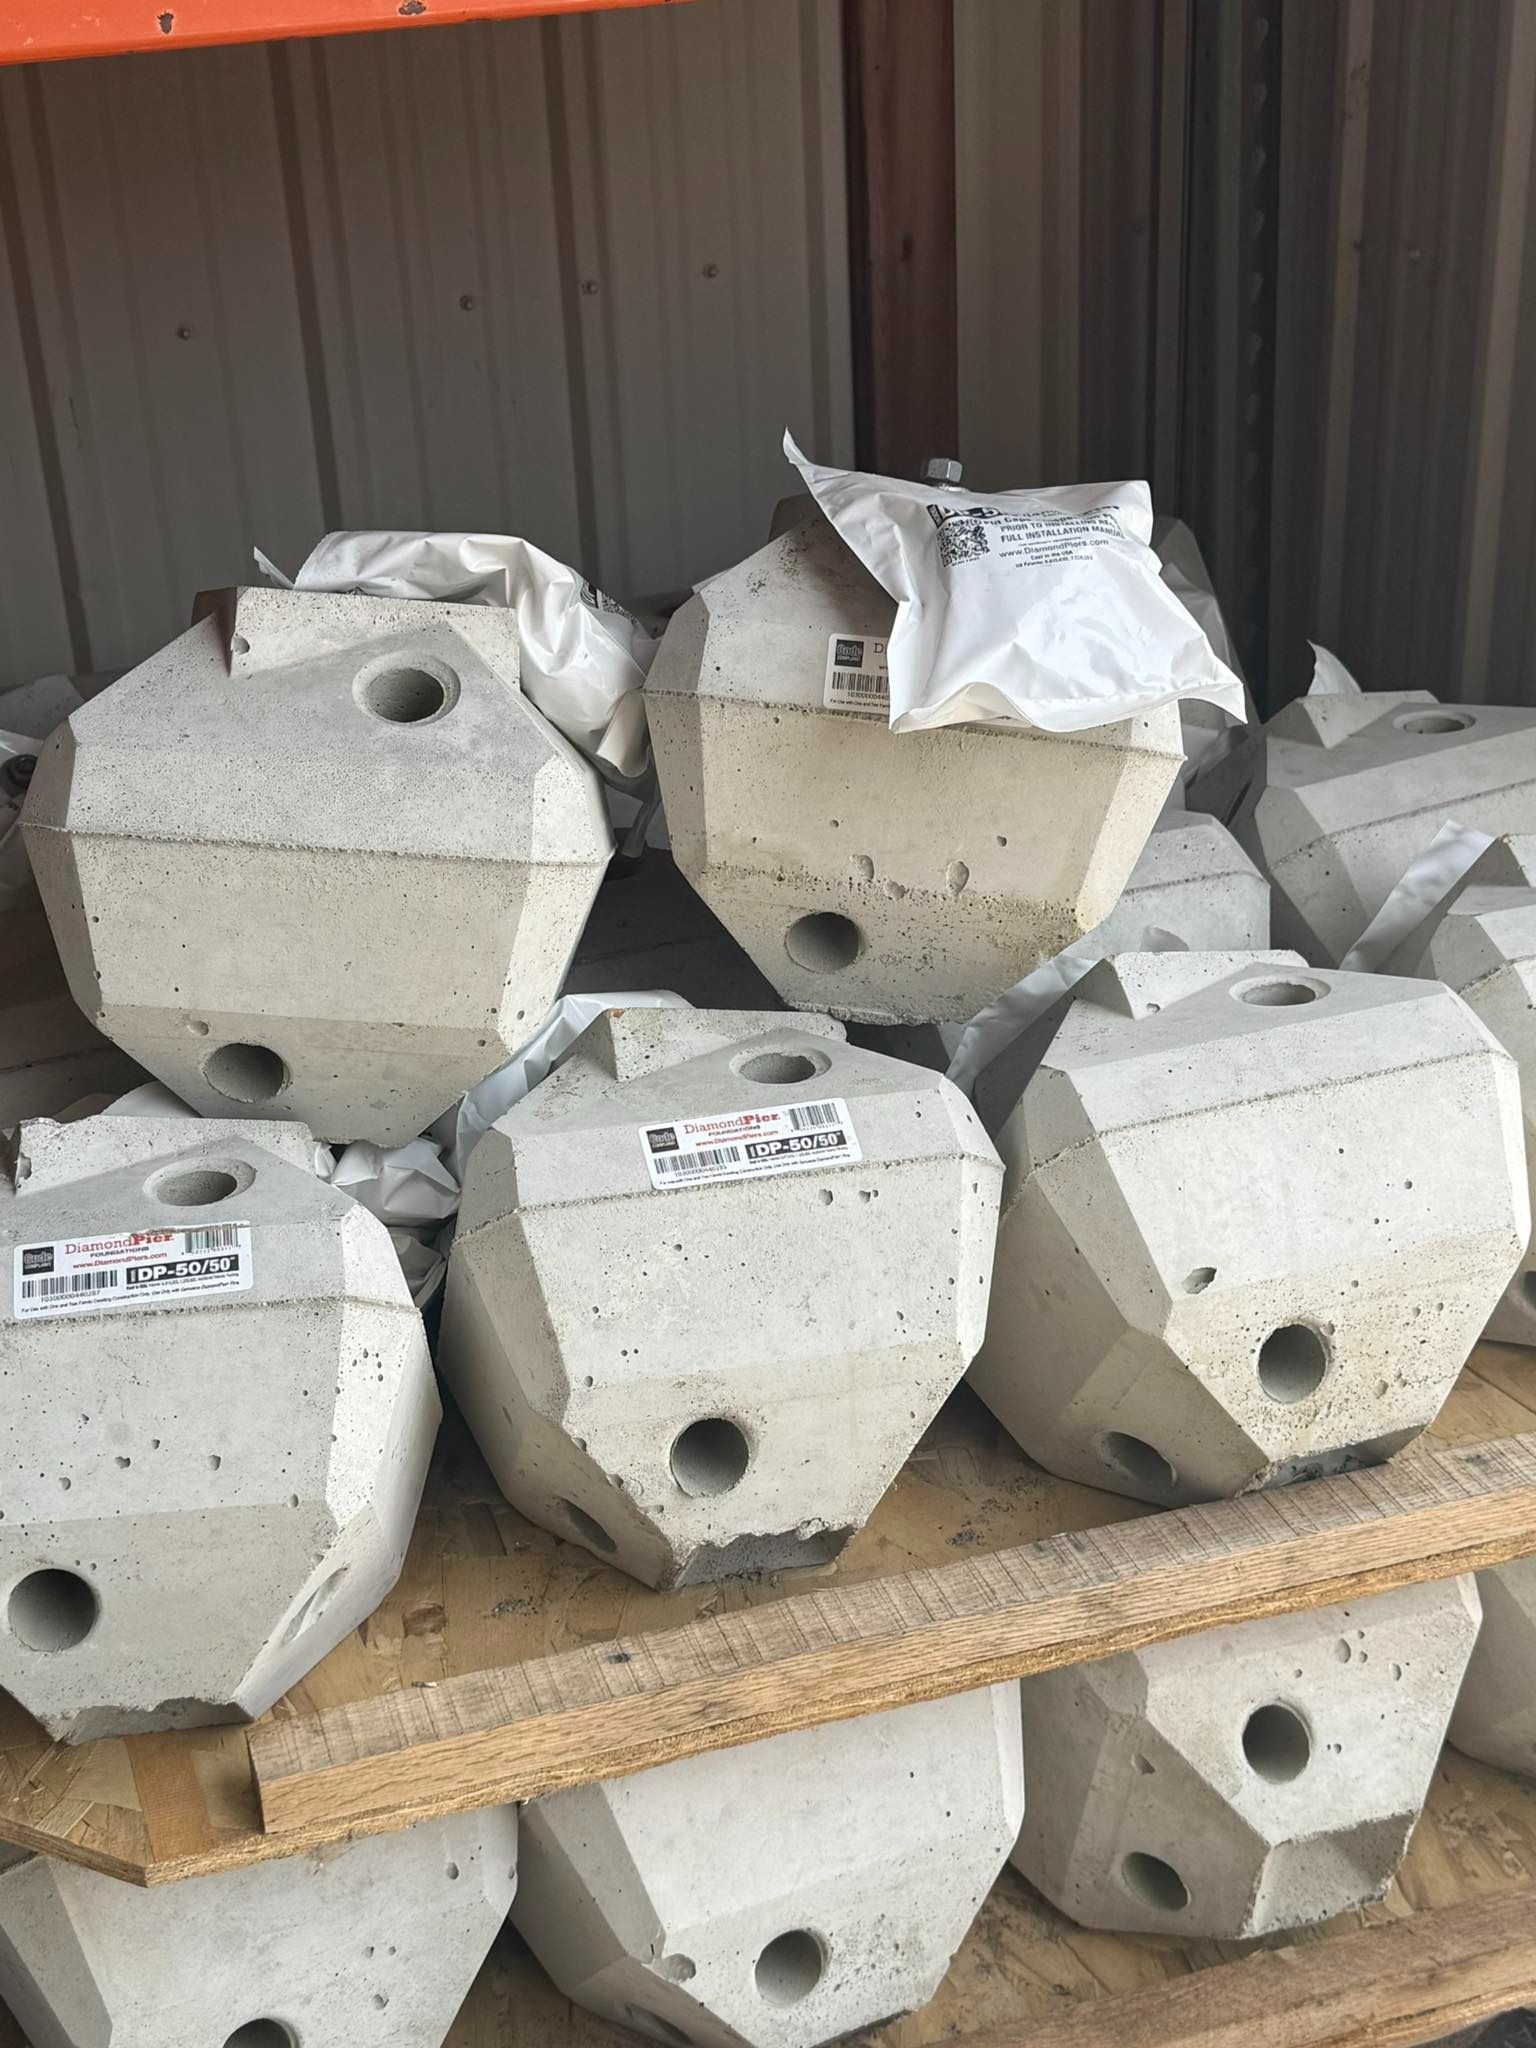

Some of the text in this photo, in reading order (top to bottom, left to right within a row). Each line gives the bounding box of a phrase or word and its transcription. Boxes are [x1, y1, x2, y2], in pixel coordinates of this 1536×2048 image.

[1000, 522, 1028, 532] PRIOR
[1000, 533, 1023, 543] FULL
[1026, 526, 1089, 539] INSTALLATION
[683, 1113, 780, 1134] DiamondPier
[90, 1245, 149, 1258] FOUNDATIONS
[73, 1252, 167, 1269] www.DiamondPiers.com
